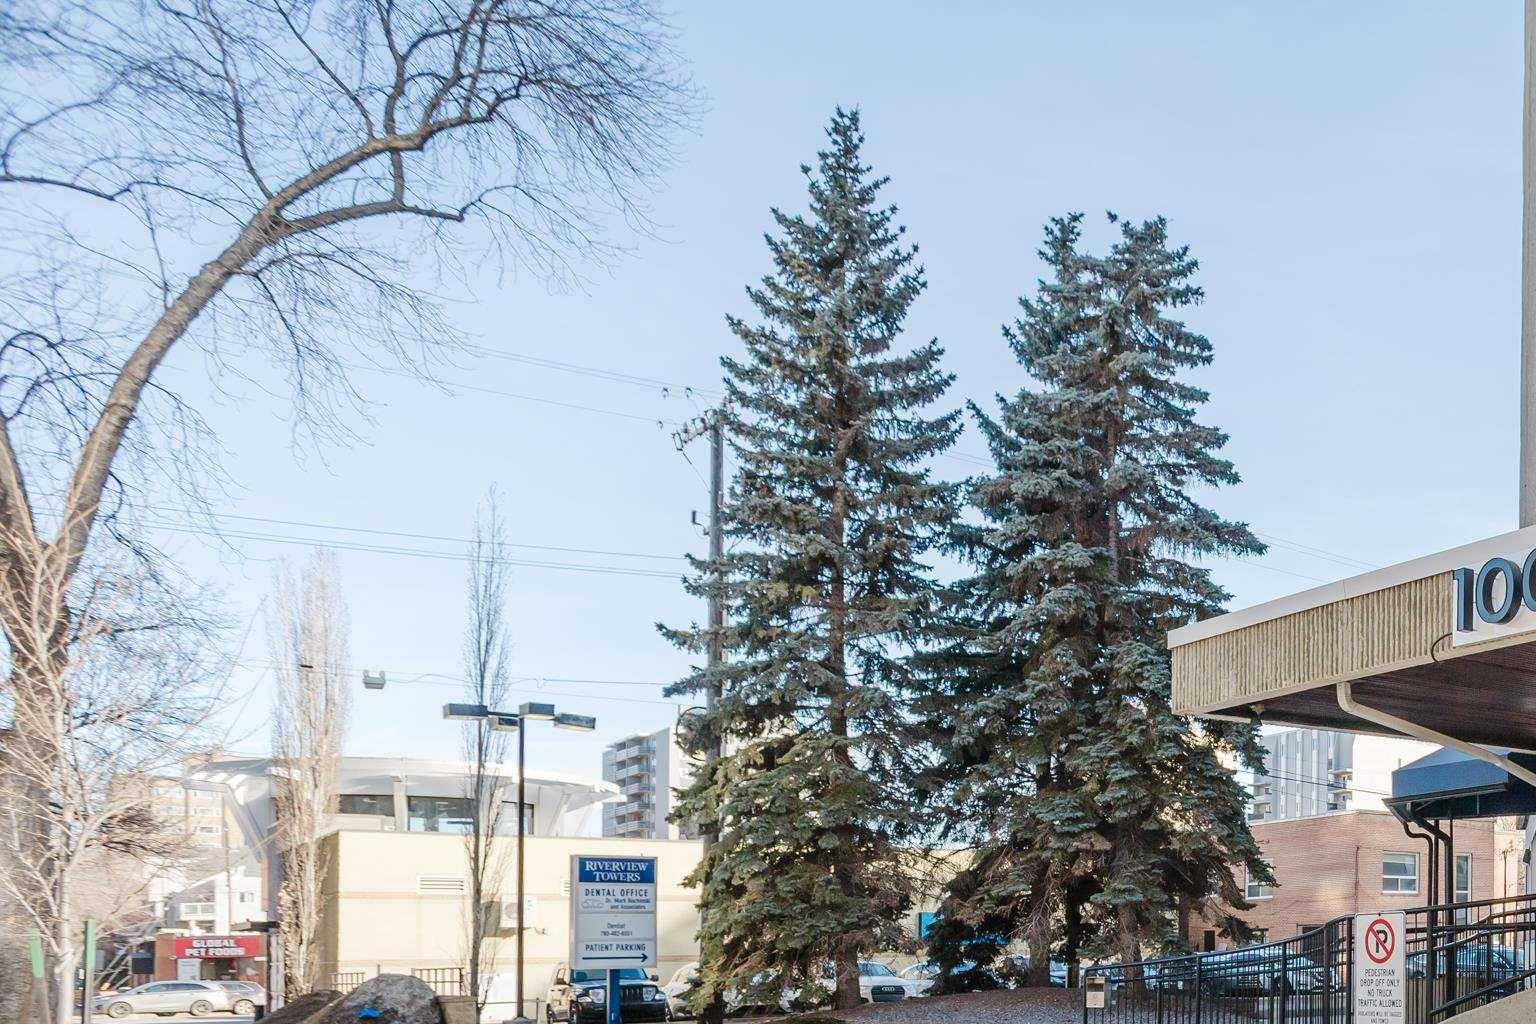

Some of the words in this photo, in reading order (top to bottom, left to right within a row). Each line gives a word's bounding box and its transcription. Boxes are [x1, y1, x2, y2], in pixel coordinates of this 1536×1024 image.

[585, 861, 648, 871] RIVERVIEW
[593, 872, 640, 882] TOWERS
[585, 888, 616, 896] DENTAL
[620, 888, 648, 896] OFFICE
[616, 944, 646, 952] PARKING
[1364, 968, 1395, 976] PEDESTRIAN
[1360, 978, 1374, 986] DROP
[1376, 978, 1385, 986] OFF
[1386, 978, 1400, 986] ONLY
[1376, 989, 1392, 997] TRUCK
[1358, 998, 1378, 1006] TRAFFIC
[1379, 999, 1402, 1008] ALLOWED
